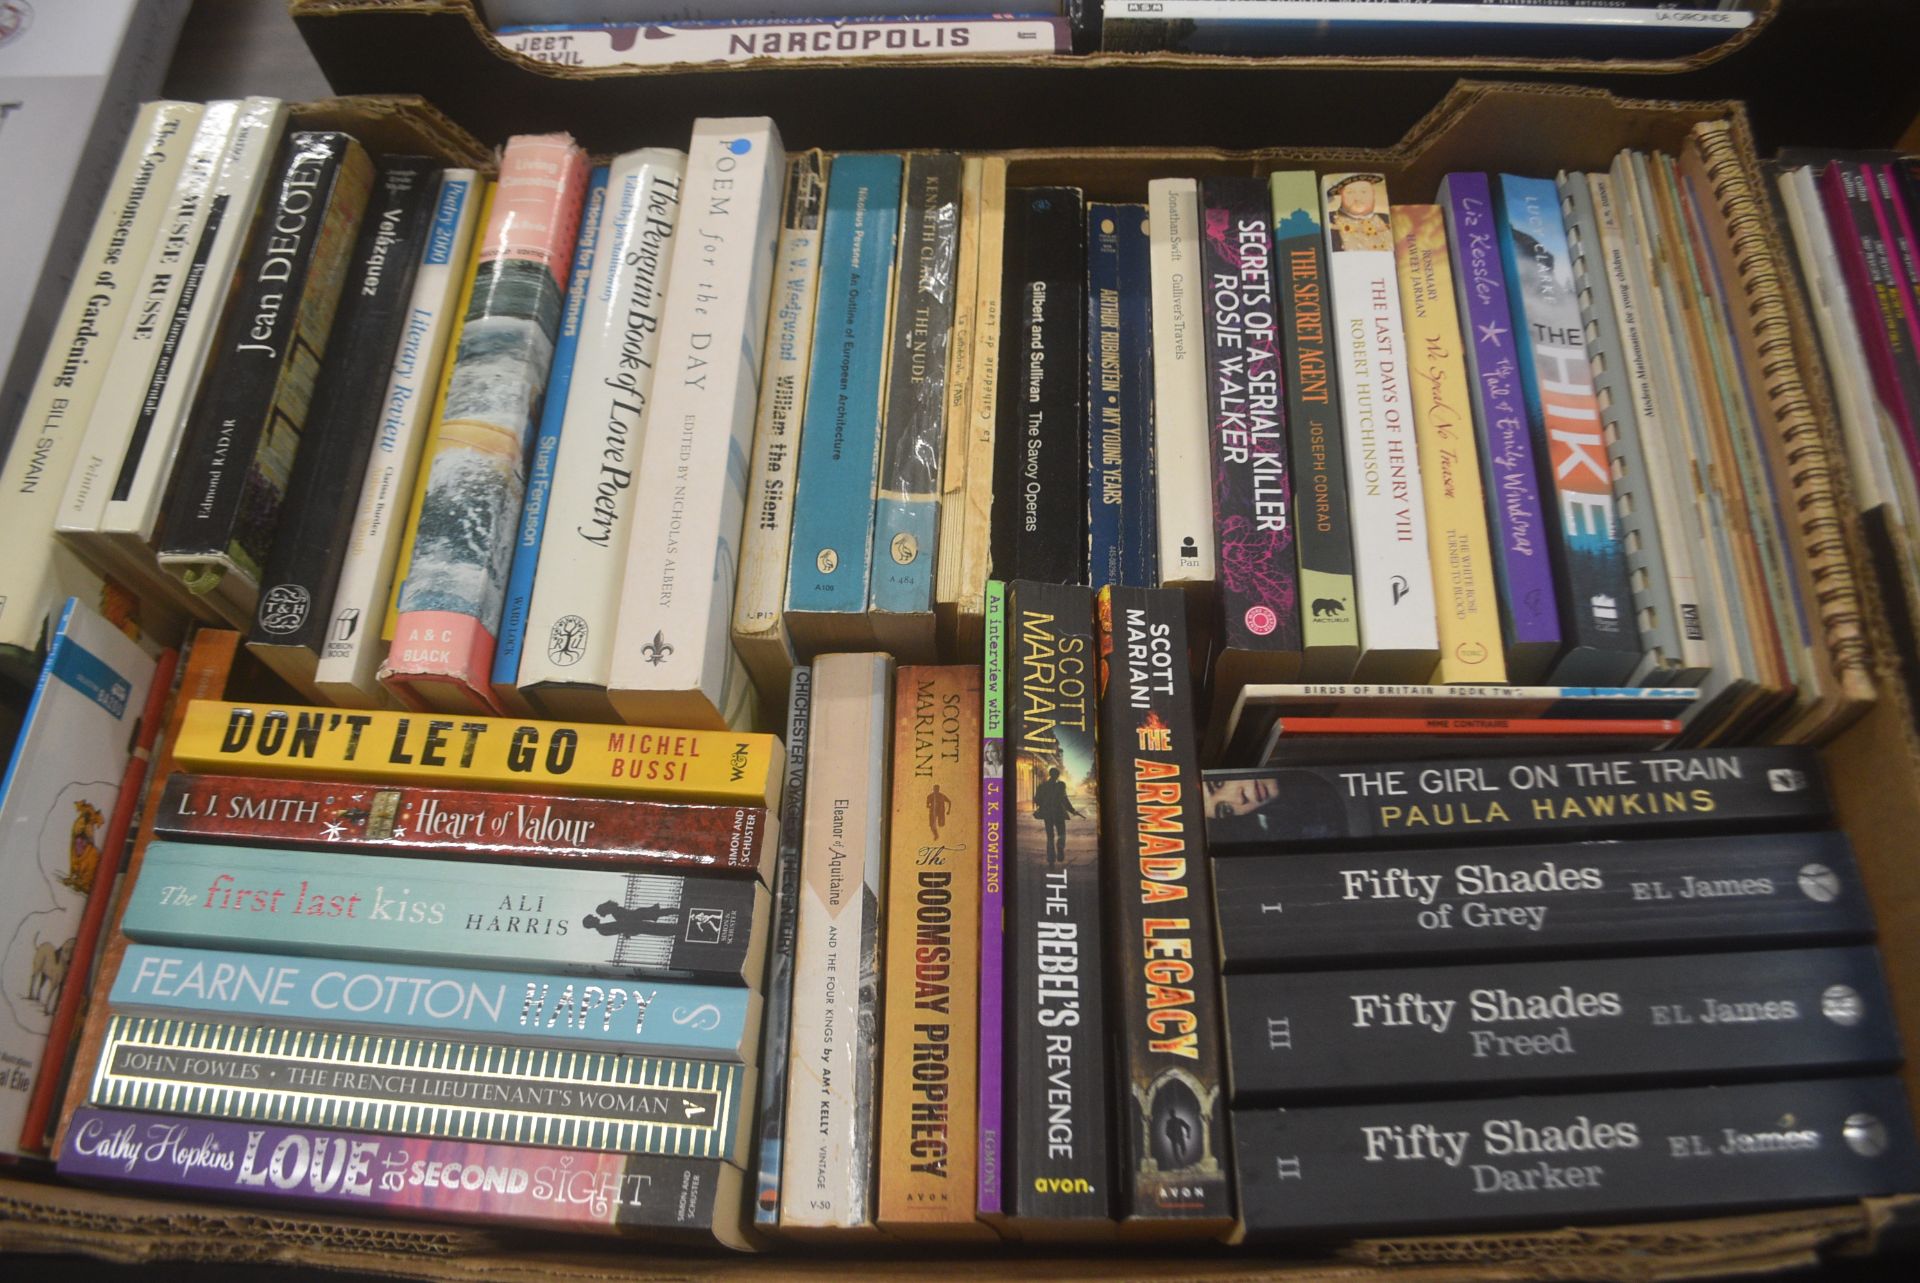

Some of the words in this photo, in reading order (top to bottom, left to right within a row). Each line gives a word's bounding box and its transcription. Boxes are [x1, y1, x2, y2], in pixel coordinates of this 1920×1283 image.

[155, 118, 180, 147] The
[104, 151, 166, 265] Commonsense
[651, 175, 684, 215] The
[1462, 197, 1484, 227] Liz
[361, 208, 403, 296] Velázquez
[626, 214, 674, 309] Penguin
[1238, 220, 1271, 306] SECRETS
[1290, 246, 1318, 282] THE
[1469, 233, 1500, 306] Kessler
[94, 270, 117, 291] of
[1032, 280, 1047, 324] Gilbert
[1371, 278, 1388, 311] THE
[914, 306, 930, 338] THE
[1100, 288, 1120, 328] ARTHUR
[1213, 273, 1243, 350] ROSIE
[1244, 310, 1274, 342] OF
[1293, 283, 1324, 344] SECRET
[53, 291, 111, 388] Gardening
[393, 308, 433, 380] Literary
[619, 304, 658, 371] Book
[1030, 324, 1046, 350] and
[1246, 347, 1273, 364] A
[1350, 318, 1371, 379] ROBERT
[1374, 316, 1394, 356] LAST
[1532, 323, 1584, 346] THE
[604, 368, 646, 400] of
[910, 341, 928, 384] NUDE
[1029, 351, 1045, 403] Sullivan
[1101, 330, 1121, 393] RUBINSTEIN
[1298, 347, 1329, 405] AGENT
[1379, 358, 1399, 409] DAYS
[44, 399, 69, 436] BILL
[380, 382, 414, 455] Review
[1029, 411, 1042, 438] The
[1101, 407, 1122, 426] MY
[1217, 355, 1249, 465] WALKER
[1247, 367, 1281, 446] SERIAL
[1384, 407, 1403, 435] OF
[604, 398, 642, 465] Love
[678, 413, 697, 465] EDITED
[1102, 427, 1122, 466] YOUNG
[1309, 420, 1327, 471] JOSEPH
[1355, 384, 1381, 497] HUTCHINSON
[1535, 343, 1617, 541] HIKE
[20, 438, 53, 494] SWAIN
[197, 467, 222, 518] Edmond
[211, 418, 236, 467] RADAR
[536, 436, 557, 477] Stuart
[676, 465, 690, 482] BY
[1026, 440, 1042, 481] Savoy
[1388, 439, 1411, 508] HENRY
[577, 464, 633, 548] Poetry
[1025, 482, 1041, 533] Operas
[1102, 466, 1123, 505] YEARS
[1252, 452, 1287, 532] KILLER
[1312, 474, 1331, 533] CONRAD
[522, 477, 550, 548] Ferguson
[664, 486, 687, 556] NICHOLAS
[1395, 508, 1413, 543] VIII
[658, 558, 677, 609] ALBERY
[1180, 558, 1200, 568] Pan
[989, 595, 1002, 613] An
[403, 649, 451, 665] BLACK
[988, 618, 1001, 693] interview
[1125, 608, 1151, 710] MARIANI
[1149, 623, 1175, 697] SCOTT
[1022, 609, 1058, 755] MARIANI
[1057, 636, 1087, 733] SCOTT
[1304, 686, 1346, 695] BIRDS
[1353, 687, 1370, 695] OF
[1378, 687, 1434, 695] BRITAIN
[1449, 688, 1487, 696] BOOK
[914, 679, 935, 778] MARIANI
[941, 694, 960, 764] SCOTT
[988, 697, 1000, 731] with
[220, 708, 372, 762] DON'T
[387, 718, 489, 769] LET
[507, 725, 579, 776] GO
[607, 730, 701, 758] MICHEL
[1134, 726, 1173, 753] THE
[610, 757, 691, 782] BUSSI
[987, 782, 999, 796] J.
[1338, 772, 1408, 797] THE
[1418, 766, 1499, 795] GIRL
[1509, 763, 1559, 791] ON
[1565, 760, 1635, 787] THE
[1640, 756, 1743, 785] TRAIN
[177, 794, 200, 816] L.
[204, 796, 223, 819] J.
[228, 796, 320, 824] SMITH
[414, 798, 488, 839] Heart
[490, 810, 514, 838] of
[517, 805, 596, 846] Valour
[733, 810, 744, 831] AND
[987, 801, 999, 816] K.
[1133, 757, 1189, 905] ARMADA
[1380, 801, 1511, 829] PAULA
[1532, 788, 1717, 822] HAWKINS
[728, 833, 741, 867] SIMON
[740, 813, 757, 864] SCHUSTER
[914, 842, 967, 868] The
[986, 822, 1000, 894] ROWLING
[160, 884, 199, 909] The
[202, 872, 287, 915] first
[293, 879, 363, 919] last
[370, 886, 446, 926] kiss
[1045, 869, 1068, 916] THE
[1340, 869, 1441, 906] Fifty
[1455, 863, 1604, 896] Shades
[1631, 880, 1674, 902] EL
[1682, 873, 1775, 899] James
[465, 913, 570, 937] HARRIS
[498, 895, 545, 914] ALI
[1417, 905, 1450, 930] of
[1461, 901, 1548, 933] Grey
[915, 870, 954, 1015] DOOMSDAY
[131, 957, 299, 1006] FEARNE
[310, 971, 506, 1022] COTTON
[1036, 920, 1081, 1029] REBEL'S
[1141, 918, 1199, 1060] LEGACY
[519, 982, 659, 1035] HAPPY
[1350, 992, 1457, 1034] Fifty
[1469, 986, 1623, 1023] Shades
[1650, 1004, 1695, 1026] EL
[1700, 997, 1799, 1024] James
[1471, 1027, 1575, 1058] Freed
[121, 1049, 180, 1074] JOHN
[181, 1057, 261, 1081] FOWLES
[286, 1066, 329, 1086] THE
[332, 1070, 416, 1096] FRENCH
[419, 1075, 572, 1107] LIEUTENANT'S
[578, 1091, 670, 1115] WOMAN
[910, 1022, 951, 1179] PROPHECY
[1045, 1035, 1074, 1160] REVENGE
[74, 1118, 142, 1174] Cathy
[143, 1124, 235, 1177] Hopkins
[236, 1129, 381, 1198] LOVE
[379, 1149, 411, 1190] at
[407, 1159, 531, 1197] SECOND
[983, 1129, 996, 1198] EGMONT
[1361, 1125, 1470, 1165] Fifty
[1483, 1116, 1640, 1156] Shades
[818, 1145, 828, 1190] VINTAGE
[1034, 1176, 1096, 1195] avon.
[1471, 1161, 1605, 1192] Darker
[906, 1192, 949, 1202] AVON
[1158, 1186, 1205, 1199] AVON
